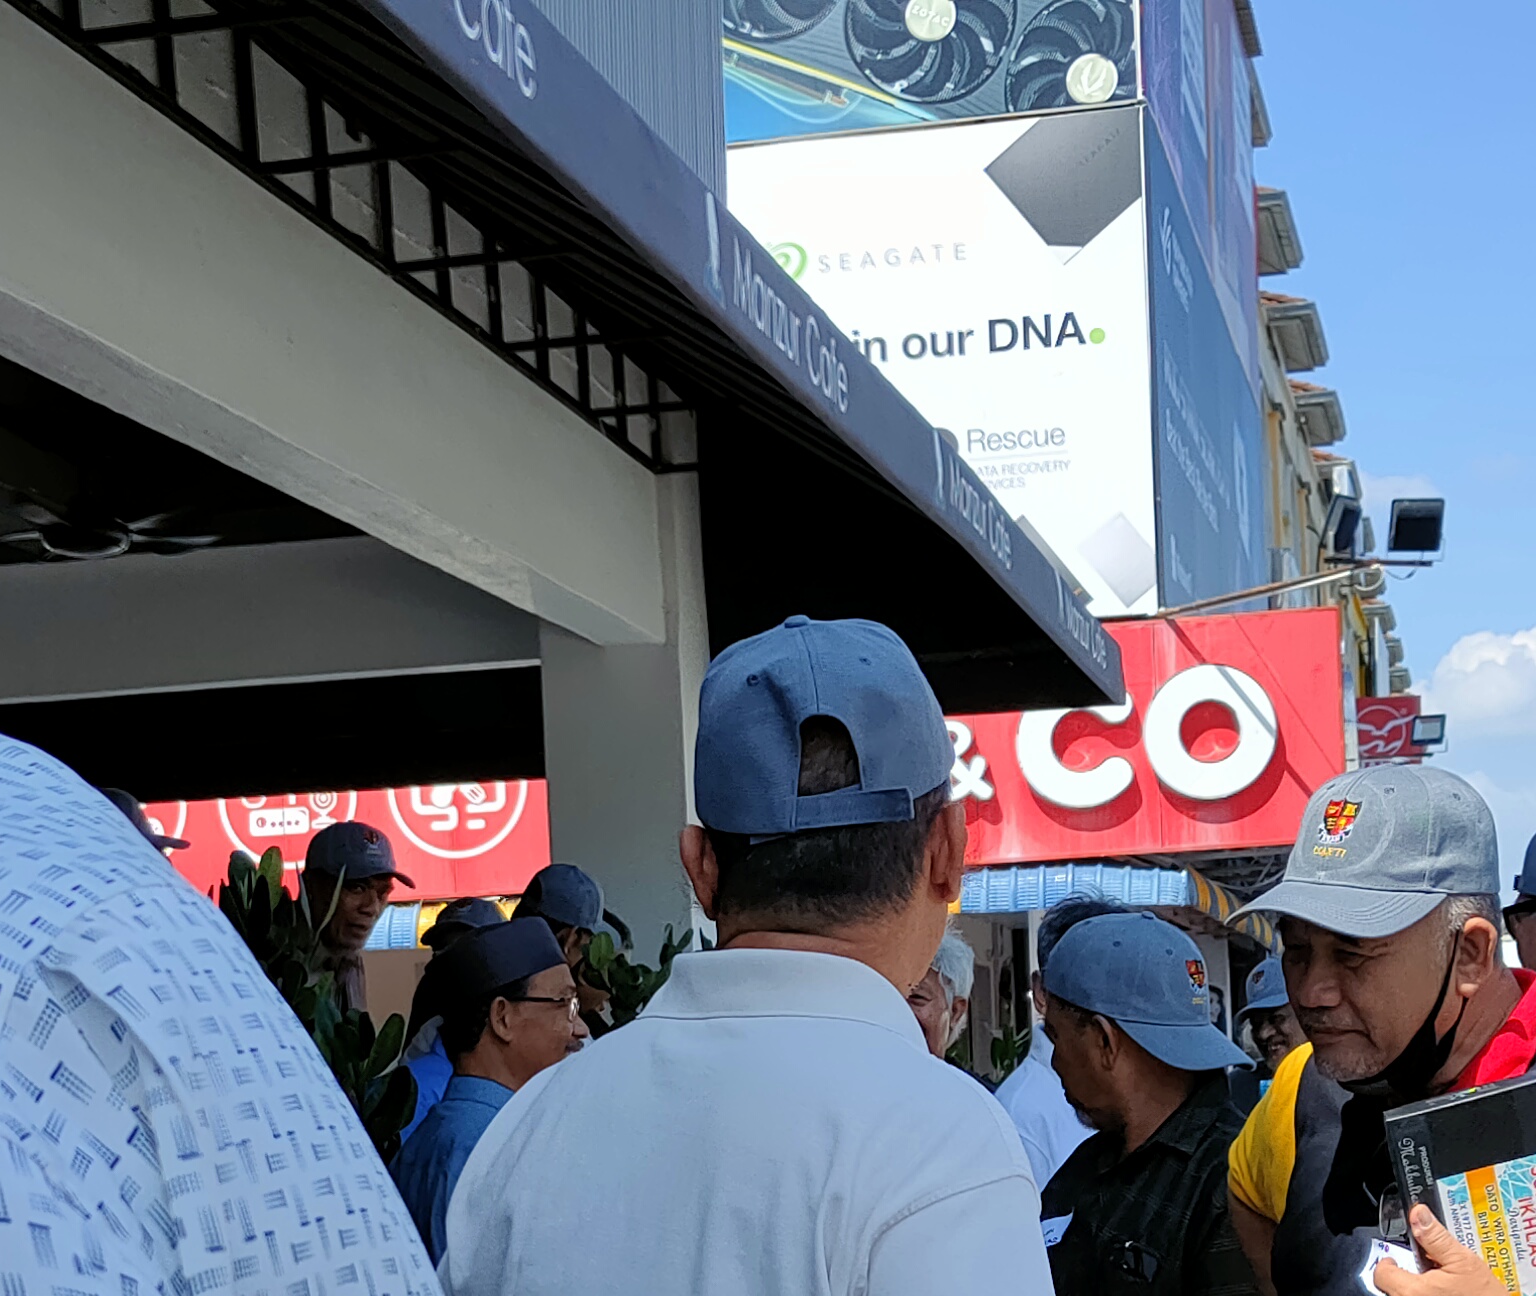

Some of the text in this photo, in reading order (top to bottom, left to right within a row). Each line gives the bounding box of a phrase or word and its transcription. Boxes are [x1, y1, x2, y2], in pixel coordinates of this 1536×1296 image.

[911, 4, 950, 27] ZOTAC
[817, 242, 967, 274] SEAGATE
[732, 234, 801, 367] Manzur
[901, 328, 975, 360] our
[966, 427, 1067, 454] Rescue
[975, 464, 1000, 478] ATA
[1017, 663, 1278, 808] CO
[1465, 1232, 1478, 1256] COLL
[1476, 1210, 1499, 1270] BIN HJ AZIZ
[1493, 1216, 1506, 1246] WIRA
[1498, 1247, 1517, 1293] OTHMAN
